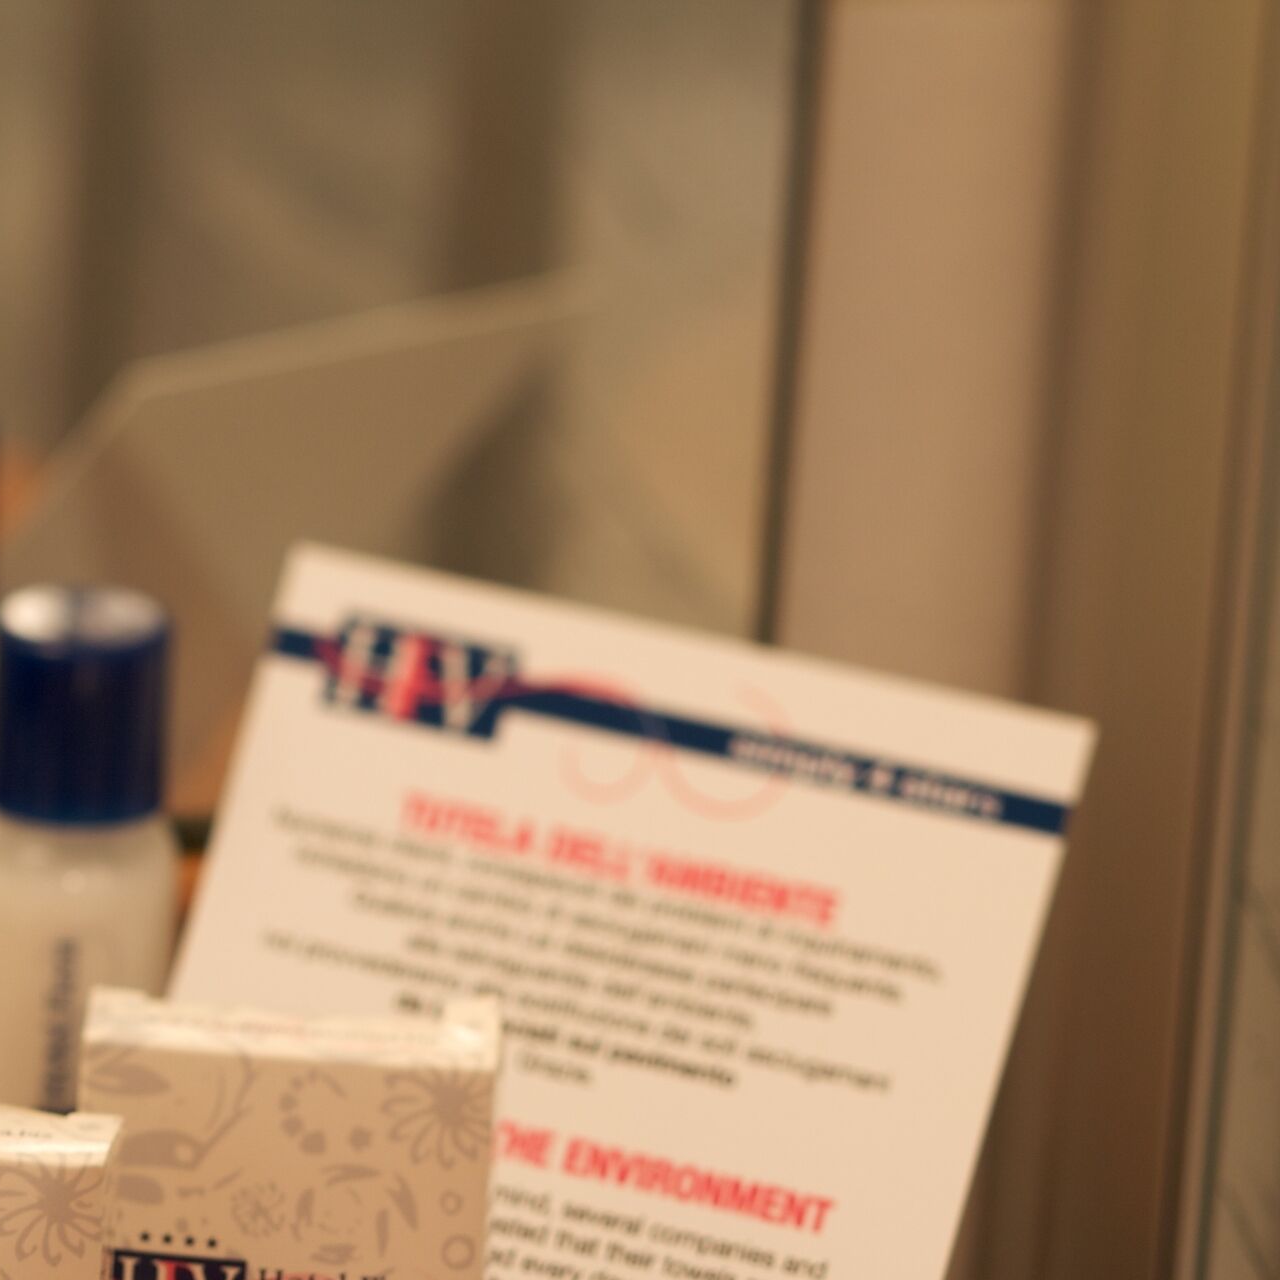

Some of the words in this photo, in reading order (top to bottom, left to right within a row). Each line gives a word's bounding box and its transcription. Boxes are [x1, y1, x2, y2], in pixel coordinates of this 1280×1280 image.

[402, 788, 537, 856] TUTELA
[561, 1136, 833, 1233] ENVIRONMENT
[554, 1230, 599, 1256] that
[605, 1242, 656, 1271] their
[562, 1201, 642, 1235] several
[648, 1223, 775, 1271] companies
[780, 1252, 828, 1280] and
